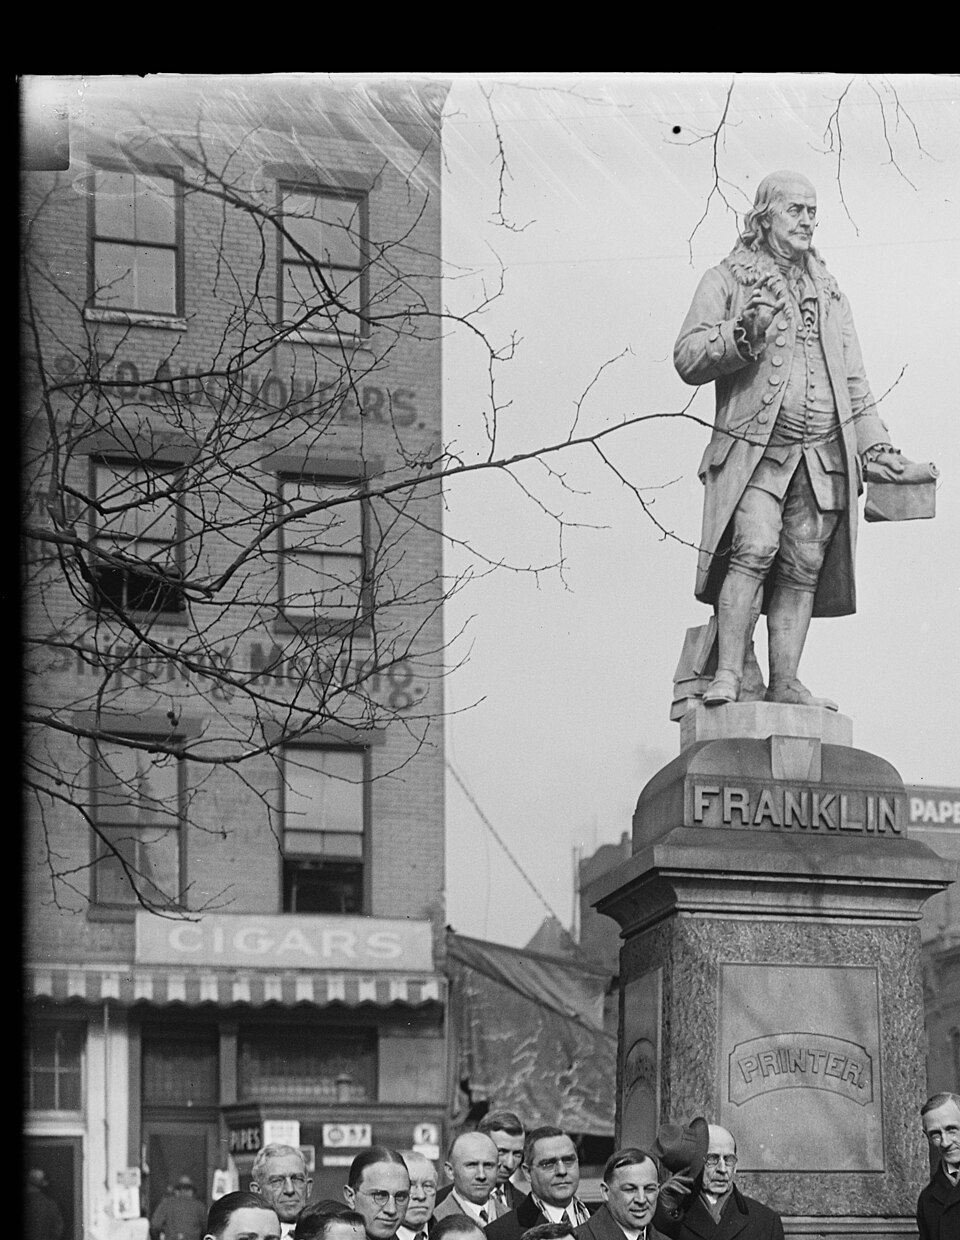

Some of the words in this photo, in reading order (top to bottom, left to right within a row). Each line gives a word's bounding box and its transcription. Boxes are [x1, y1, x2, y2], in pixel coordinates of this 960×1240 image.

[45, 628, 234, 702] Shipping
[693, 785, 901, 833] FRANKLIN
[168, 927, 402, 958] CIGARS
[229, 1128, 260, 1151] PIPES
